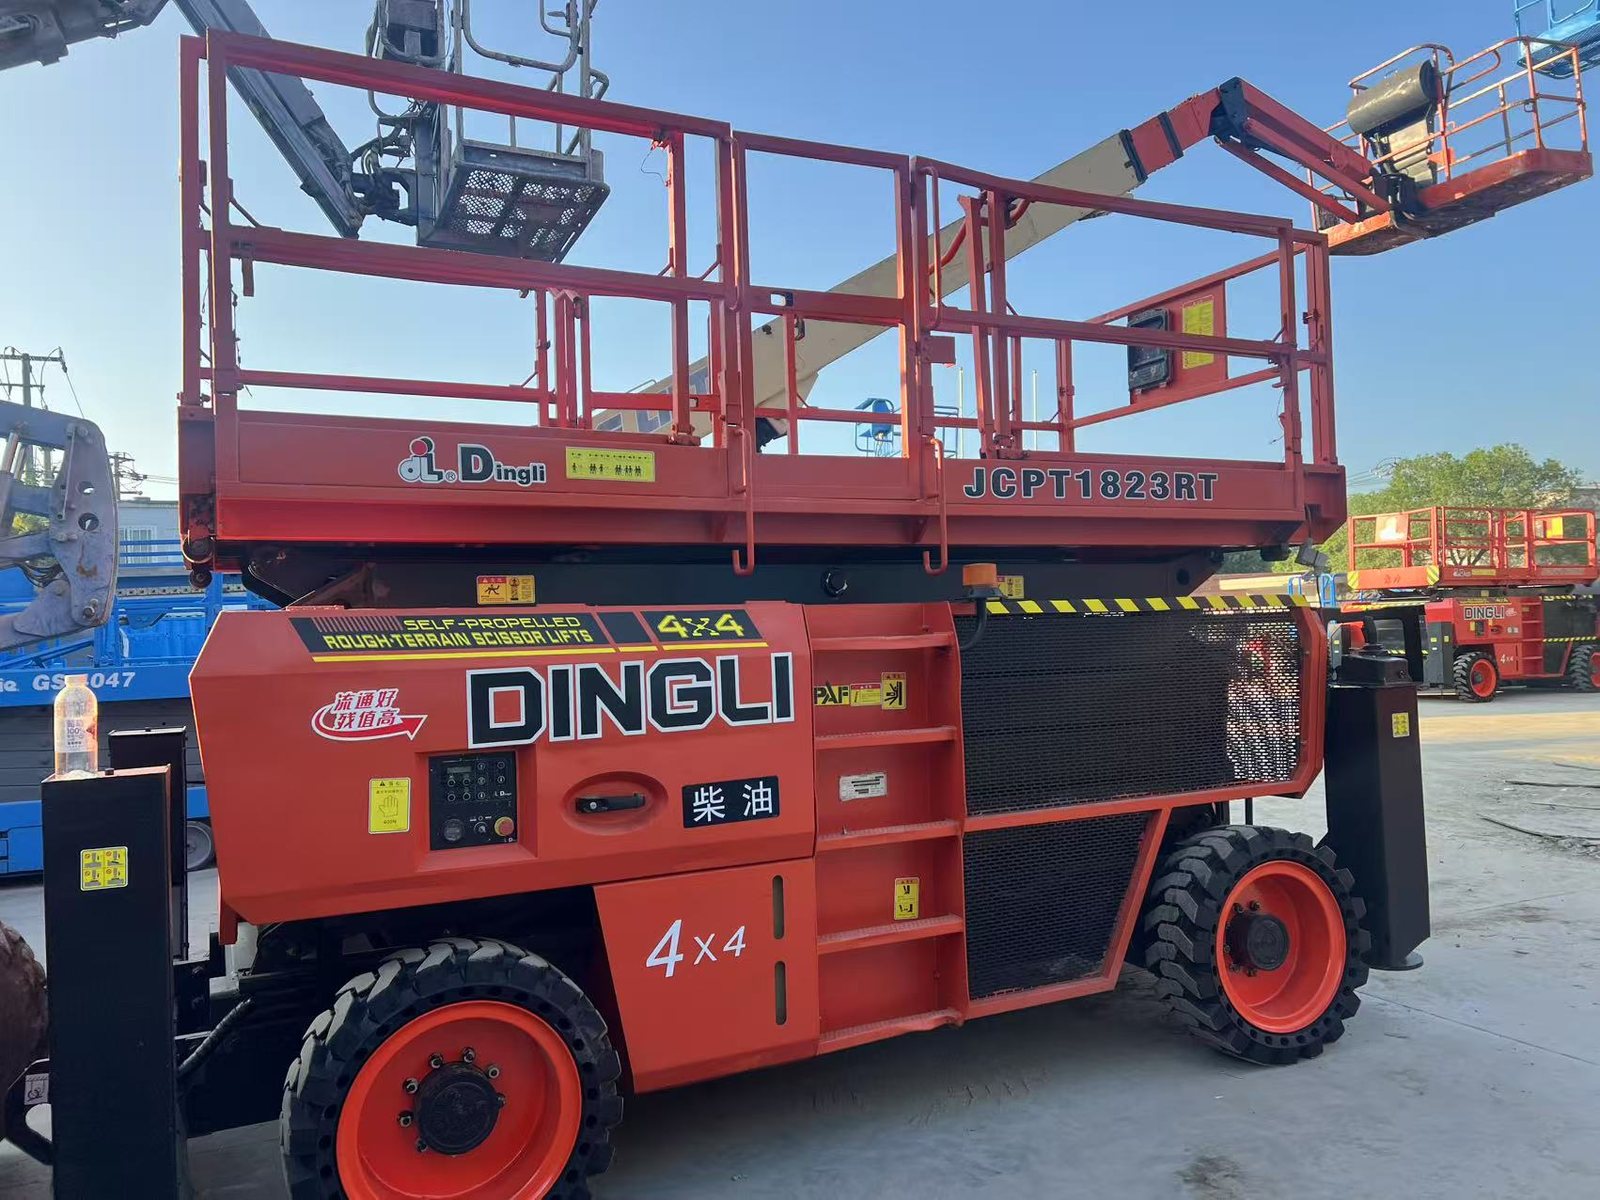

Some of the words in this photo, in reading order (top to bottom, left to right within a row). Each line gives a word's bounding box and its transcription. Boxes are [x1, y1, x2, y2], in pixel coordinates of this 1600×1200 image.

[458, 444, 546, 487] Dingli
[963, 466, 1219, 501] JCPT1823RT
[1464, 605, 1505, 620] DINGLI
[402, 616, 582, 631] SELF-PROPELLED
[471, 630, 547, 646] SCISSOR
[545, 629, 594, 643] LIFTS
[32, 671, 136, 691] GS047
[334, 690, 396, 711] 流通好
[465, 651, 795, 749] DINGLI
[334, 709, 397, 730] 残值高
[693, 780, 774, 823] 柴油
